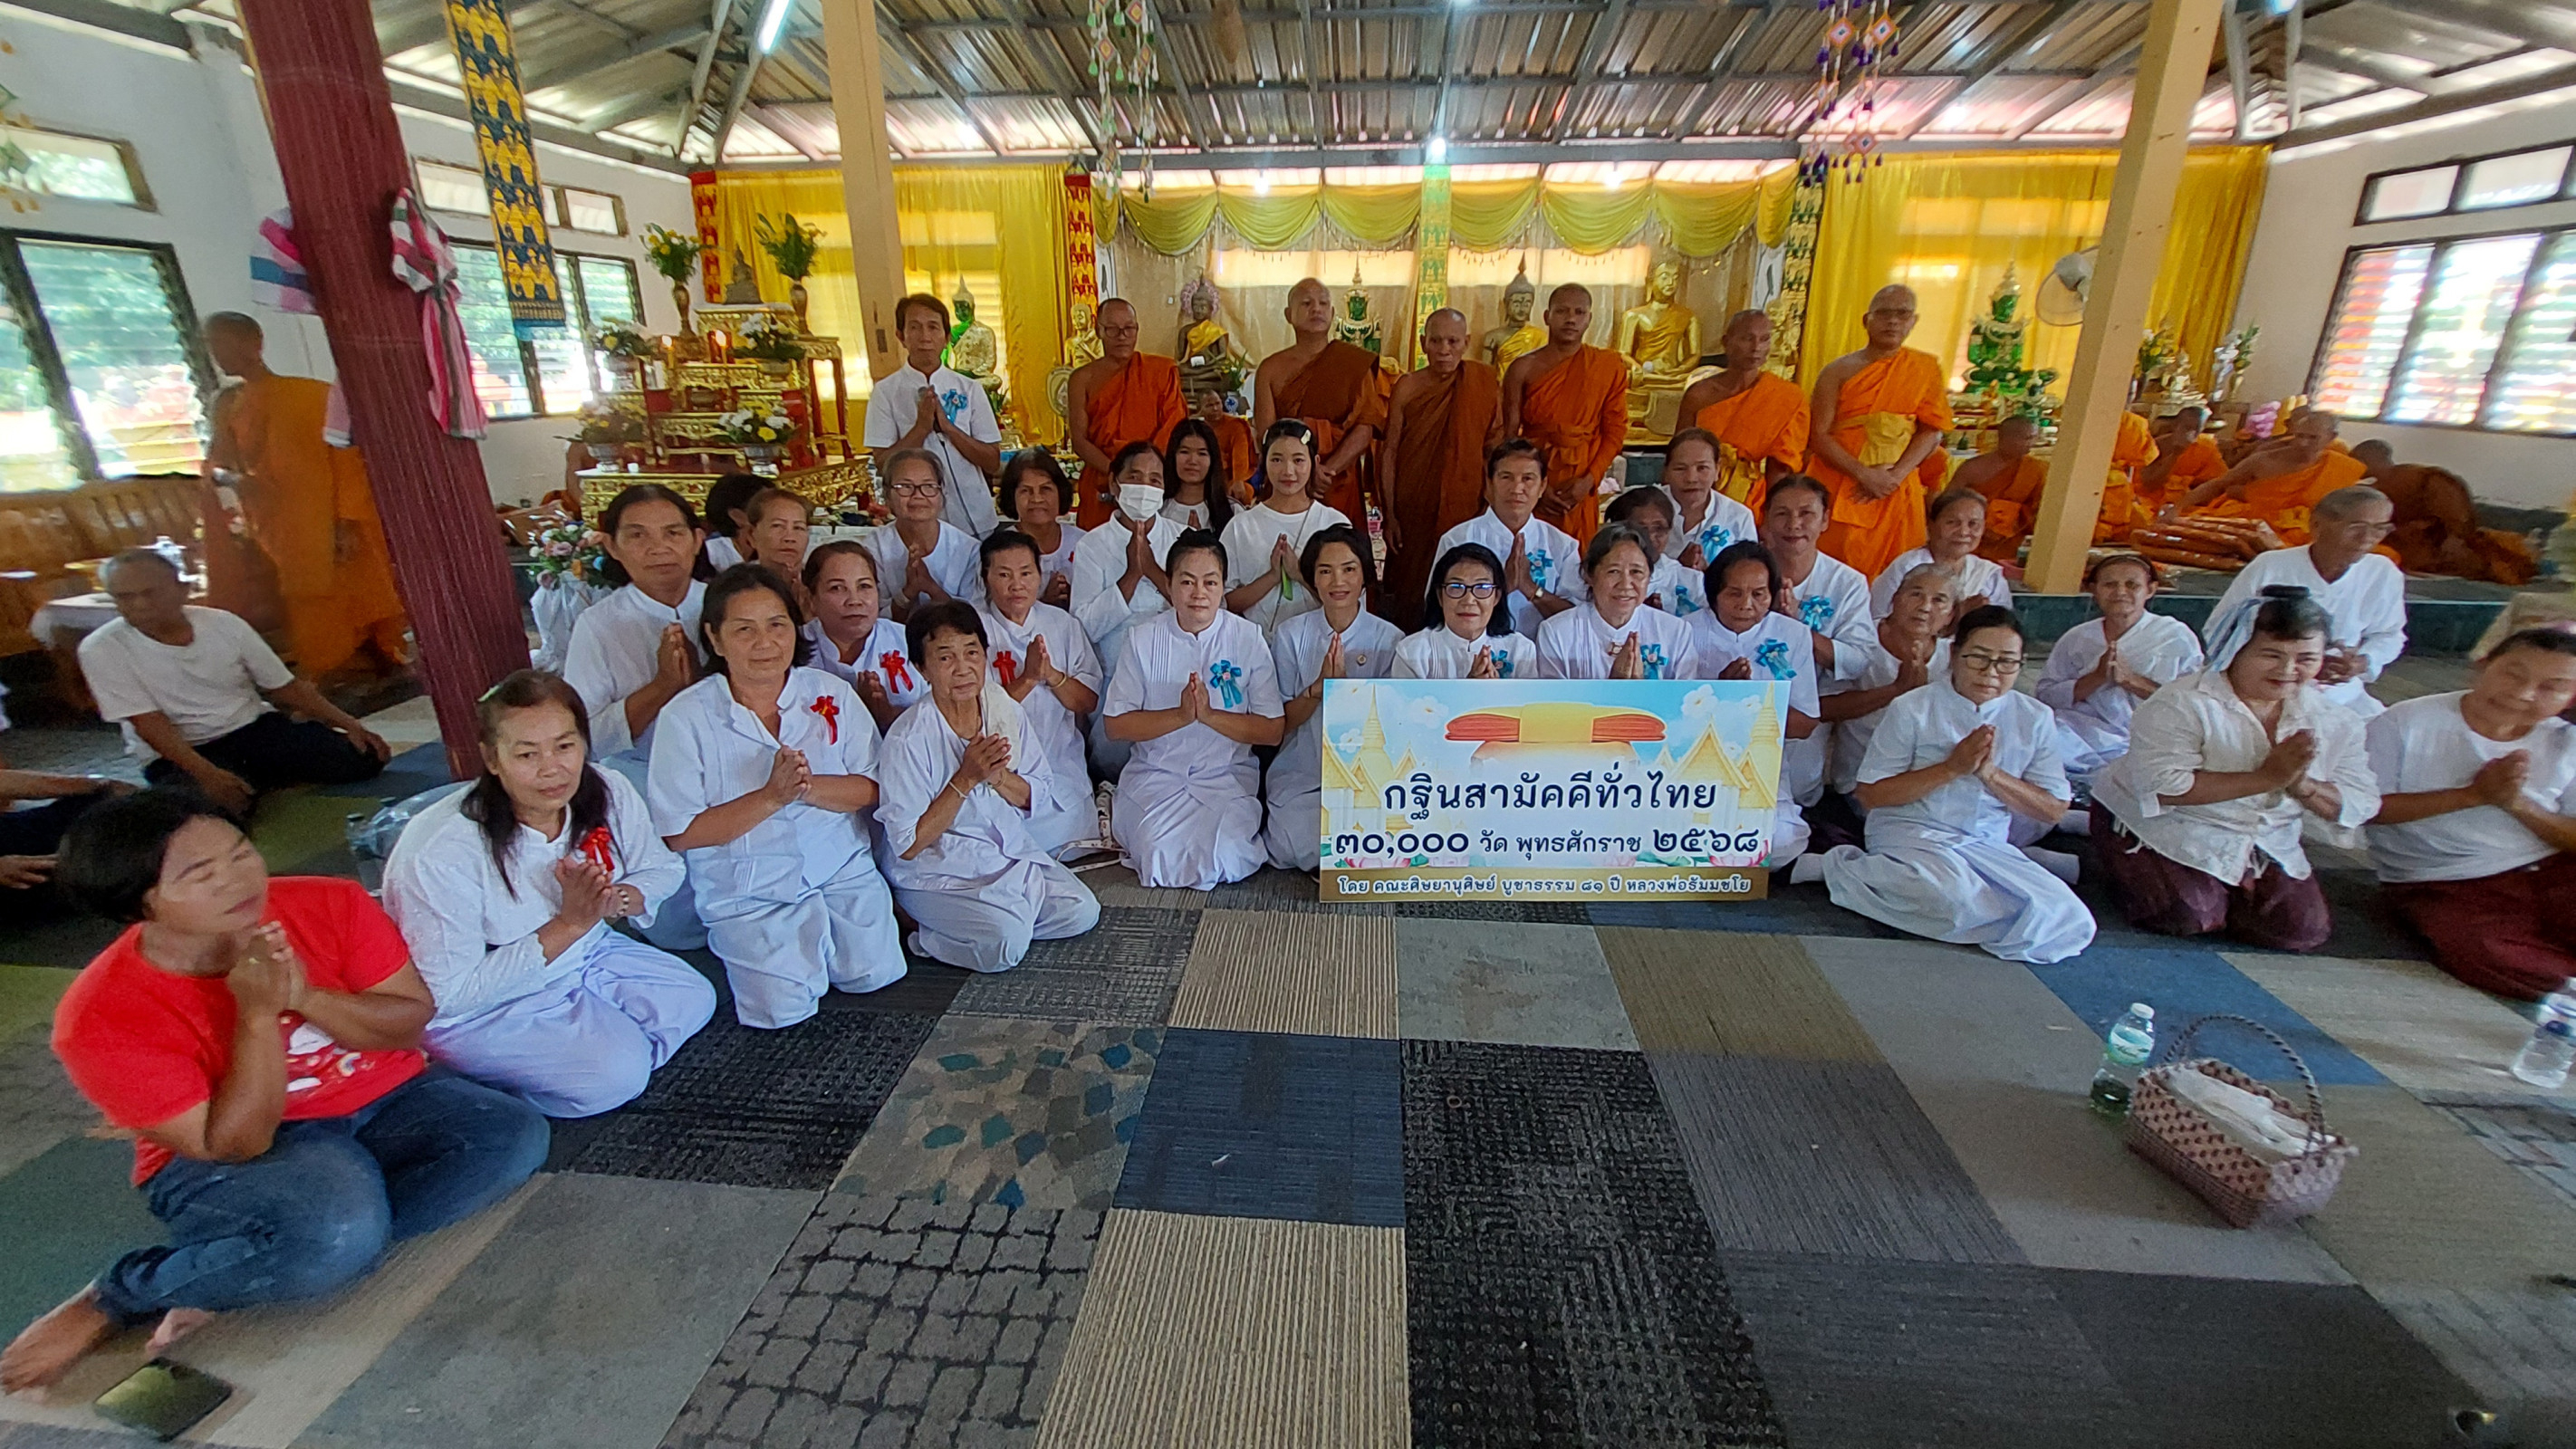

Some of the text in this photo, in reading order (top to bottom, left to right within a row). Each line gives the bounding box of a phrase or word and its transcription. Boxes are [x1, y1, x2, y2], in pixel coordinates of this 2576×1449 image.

[1384, 762, 1716, 820] กฐินสามัคคีทั่วไทย
[1335, 828, 1760, 860] ๓๐,๐๐๐ วัด พุทธศักราช ๒๕๖๘
[1338, 874, 1752, 896] โดย คณะศิษยานุศิษย์ บูชาธรรม ๘๑ ปี หลวงพ่อธัมมชโย
